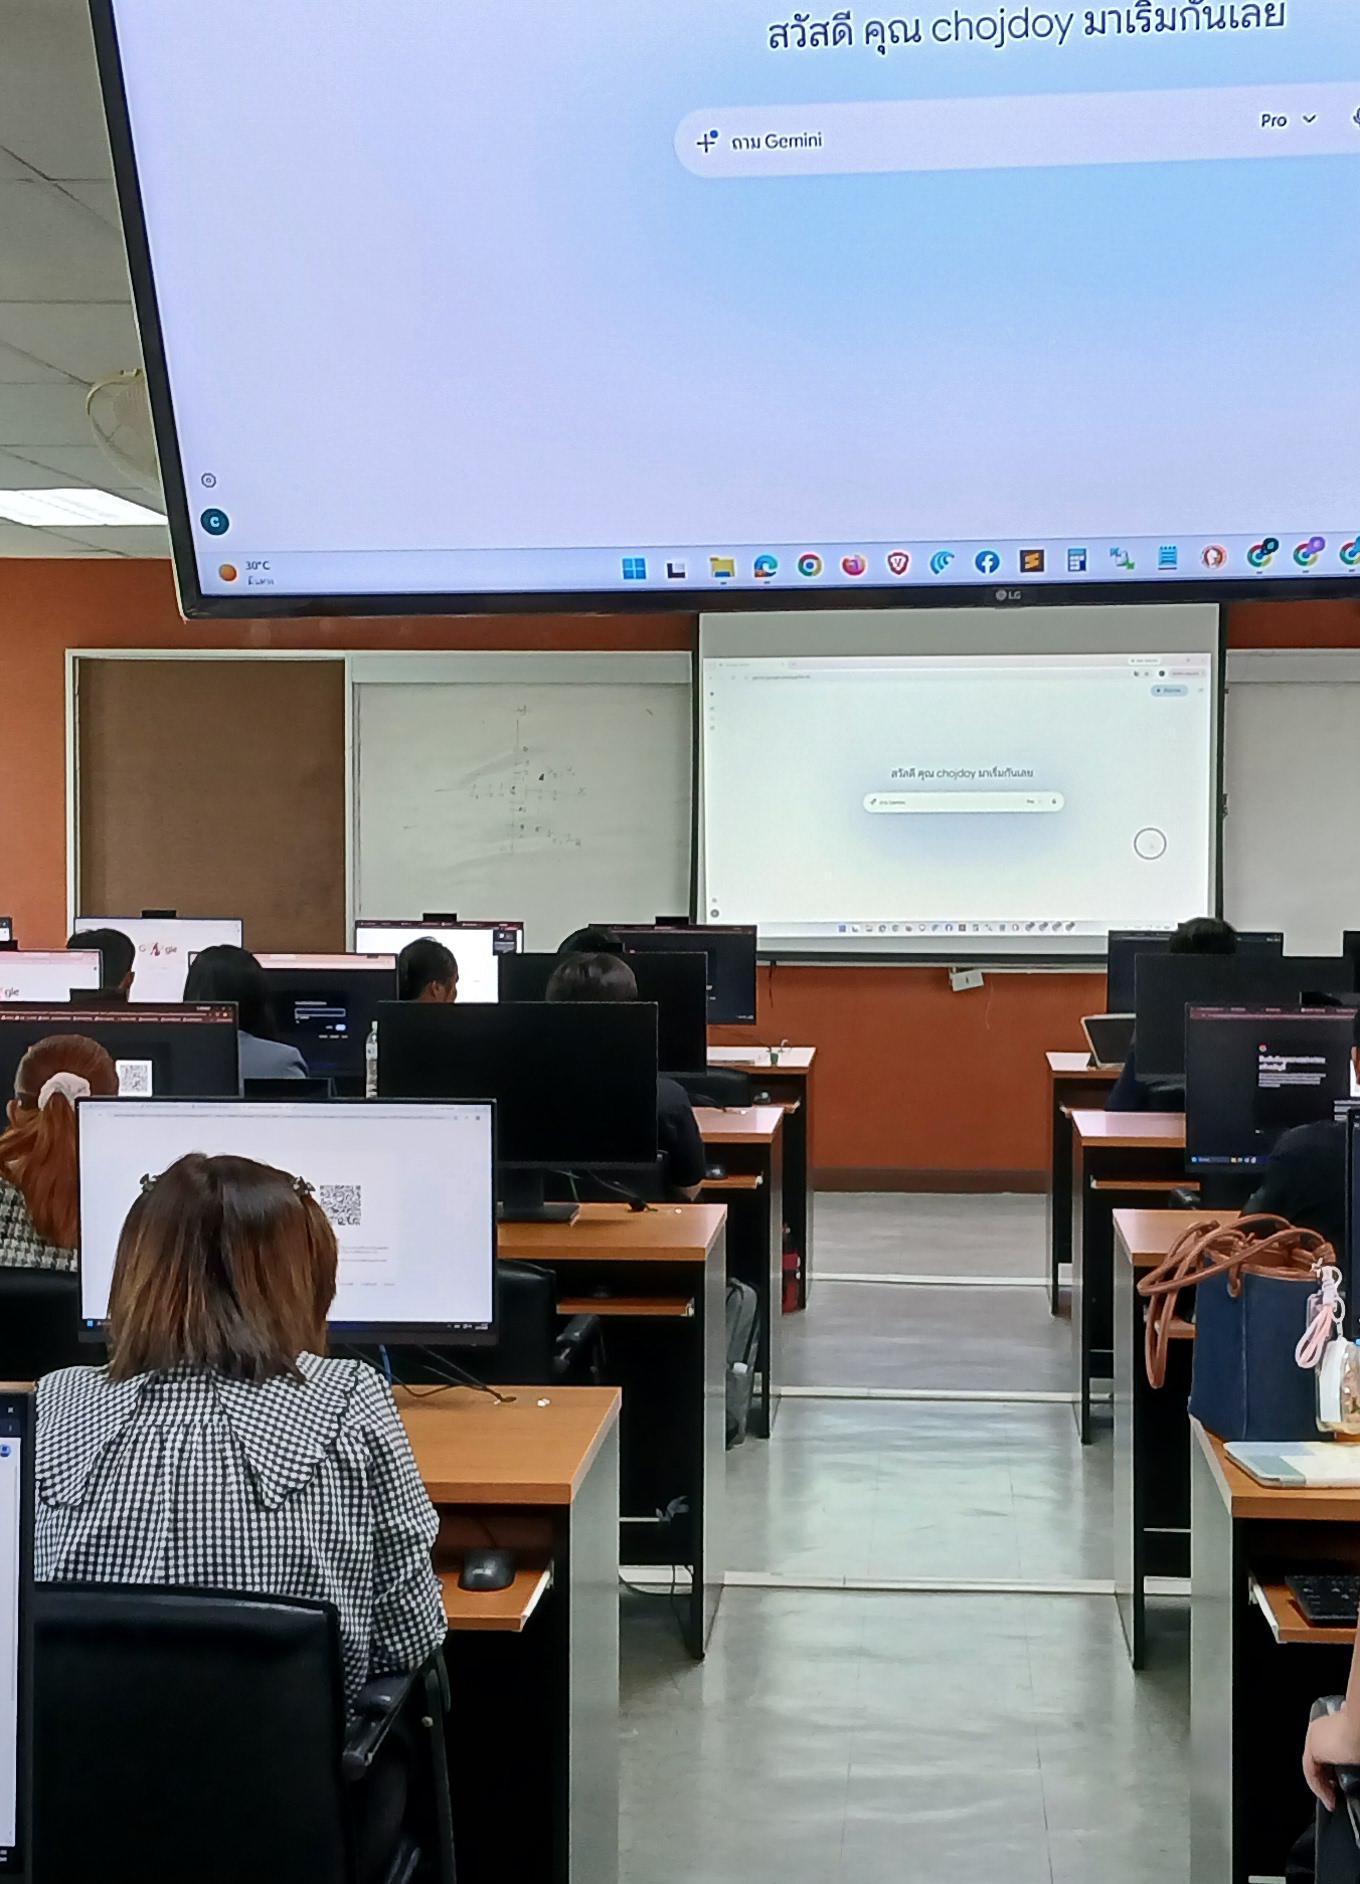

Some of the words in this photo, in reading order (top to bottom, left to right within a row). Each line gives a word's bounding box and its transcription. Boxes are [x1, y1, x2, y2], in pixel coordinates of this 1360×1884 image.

[769, 10, 853, 48] สวัสดี
[865, 18, 922, 55] คุณ
[932, 7, 1074, 48] chojdoy
[1085, 0, 1285, 35] มาเริมกนเลย
[1261, 113, 1287, 127] Pro
[731, 137, 761, 149] ถาม
[764, 132, 822, 149] Gemini
